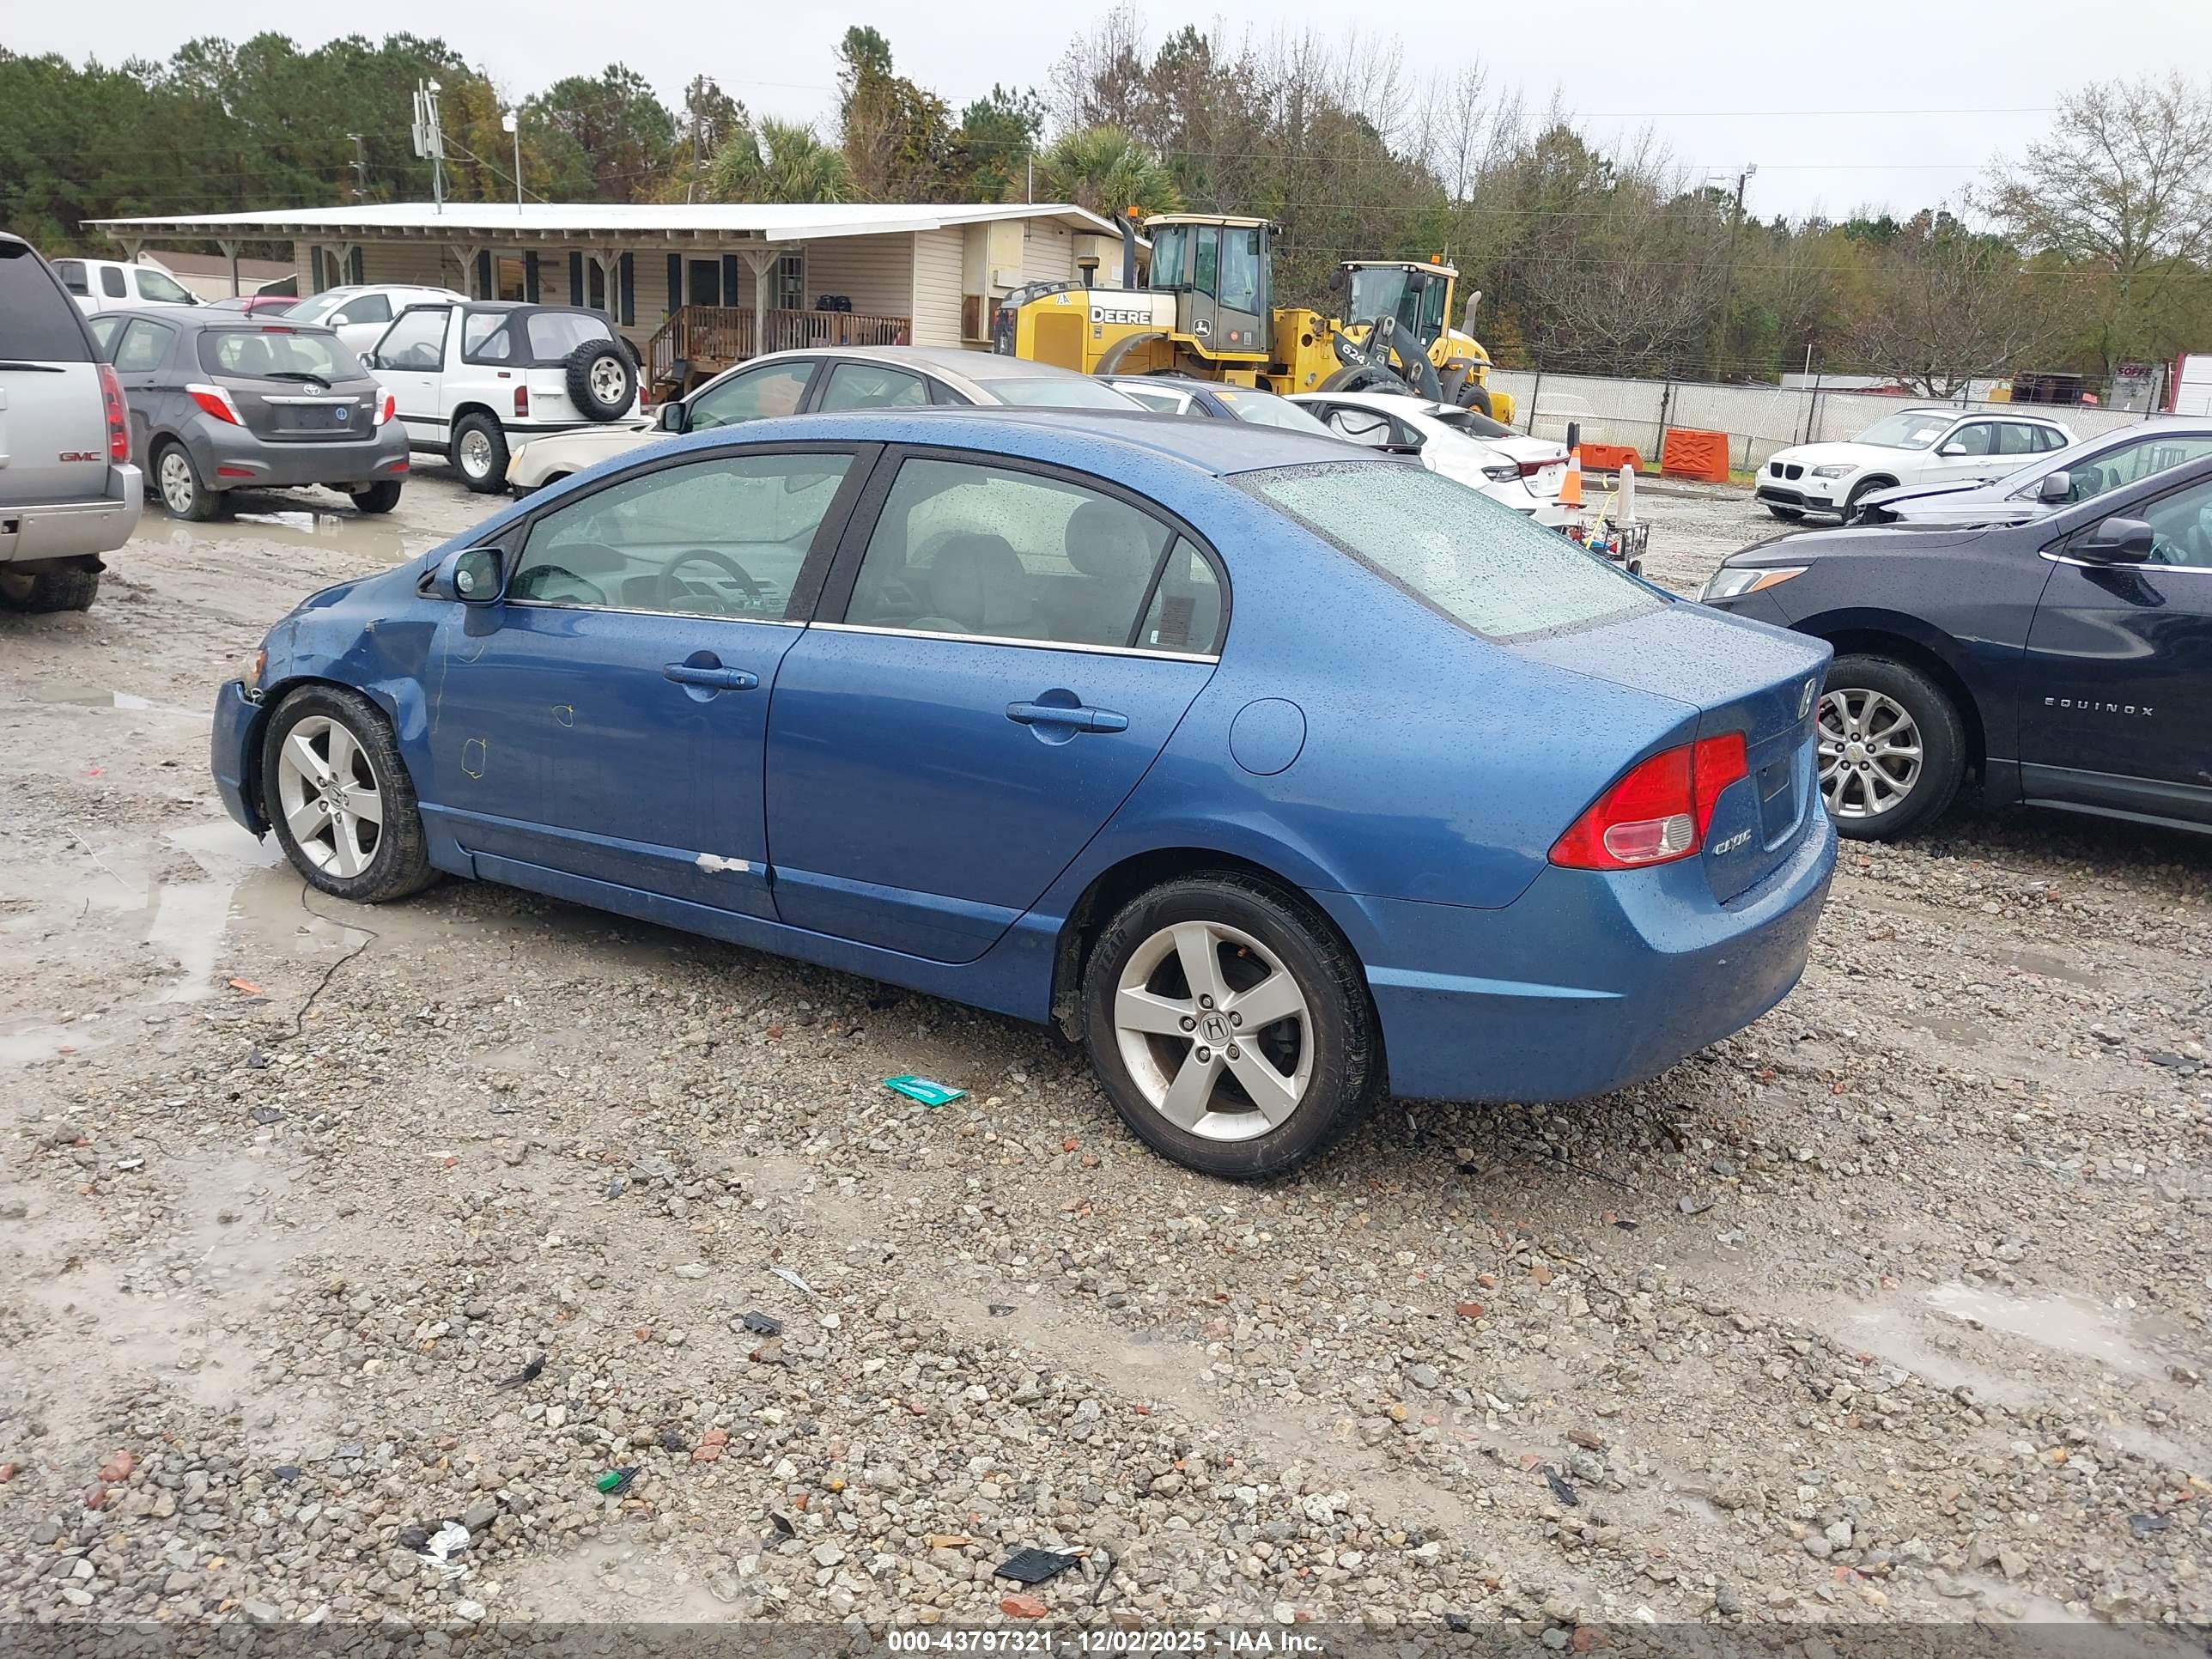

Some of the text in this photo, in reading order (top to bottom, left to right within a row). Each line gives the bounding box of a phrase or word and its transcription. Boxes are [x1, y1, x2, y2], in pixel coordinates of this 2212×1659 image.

[1091, 306, 1151, 325] DEERE
[59, 452, 102, 461] GMC
[2044, 696, 2154, 716] EQUINOX
[1712, 828, 1753, 856] CIVIC
